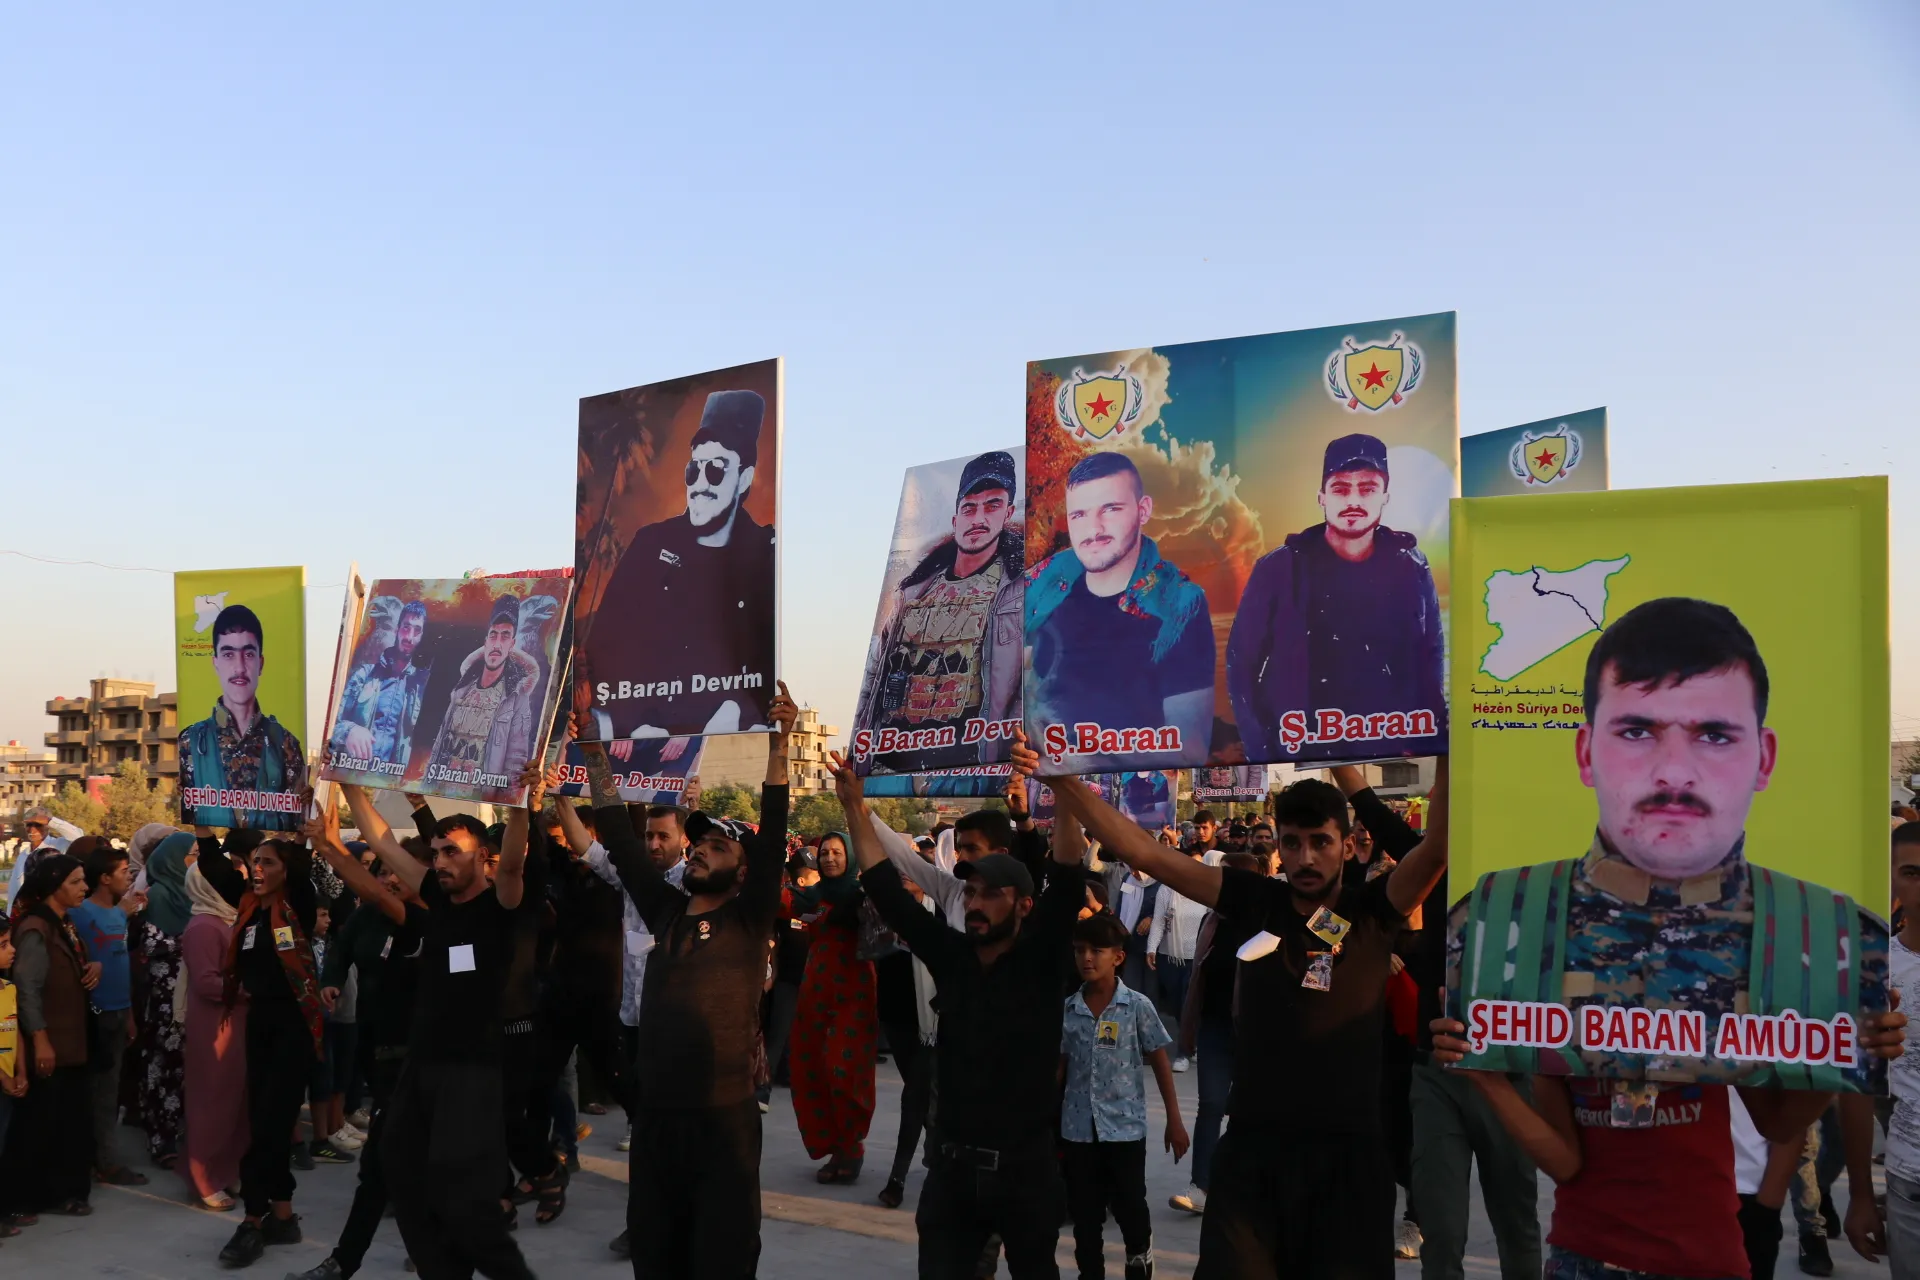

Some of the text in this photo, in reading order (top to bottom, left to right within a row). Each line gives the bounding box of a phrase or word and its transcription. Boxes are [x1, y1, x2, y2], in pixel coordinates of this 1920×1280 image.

[596, 680, 683, 706] Ş.Baran
[854, 728, 955, 762] Ş.Baran
[1044, 724, 1182, 765] Ş.Baran
[1280, 709, 1436, 753] Ş.Baran
[427, 763, 469, 784] Ş.Baran
[626, 771, 686, 792] Devrm
[220, 789, 257, 810] BARAN
[1469, 1001, 1856, 1066] ŞEHID BARAN AMÛDÊ
